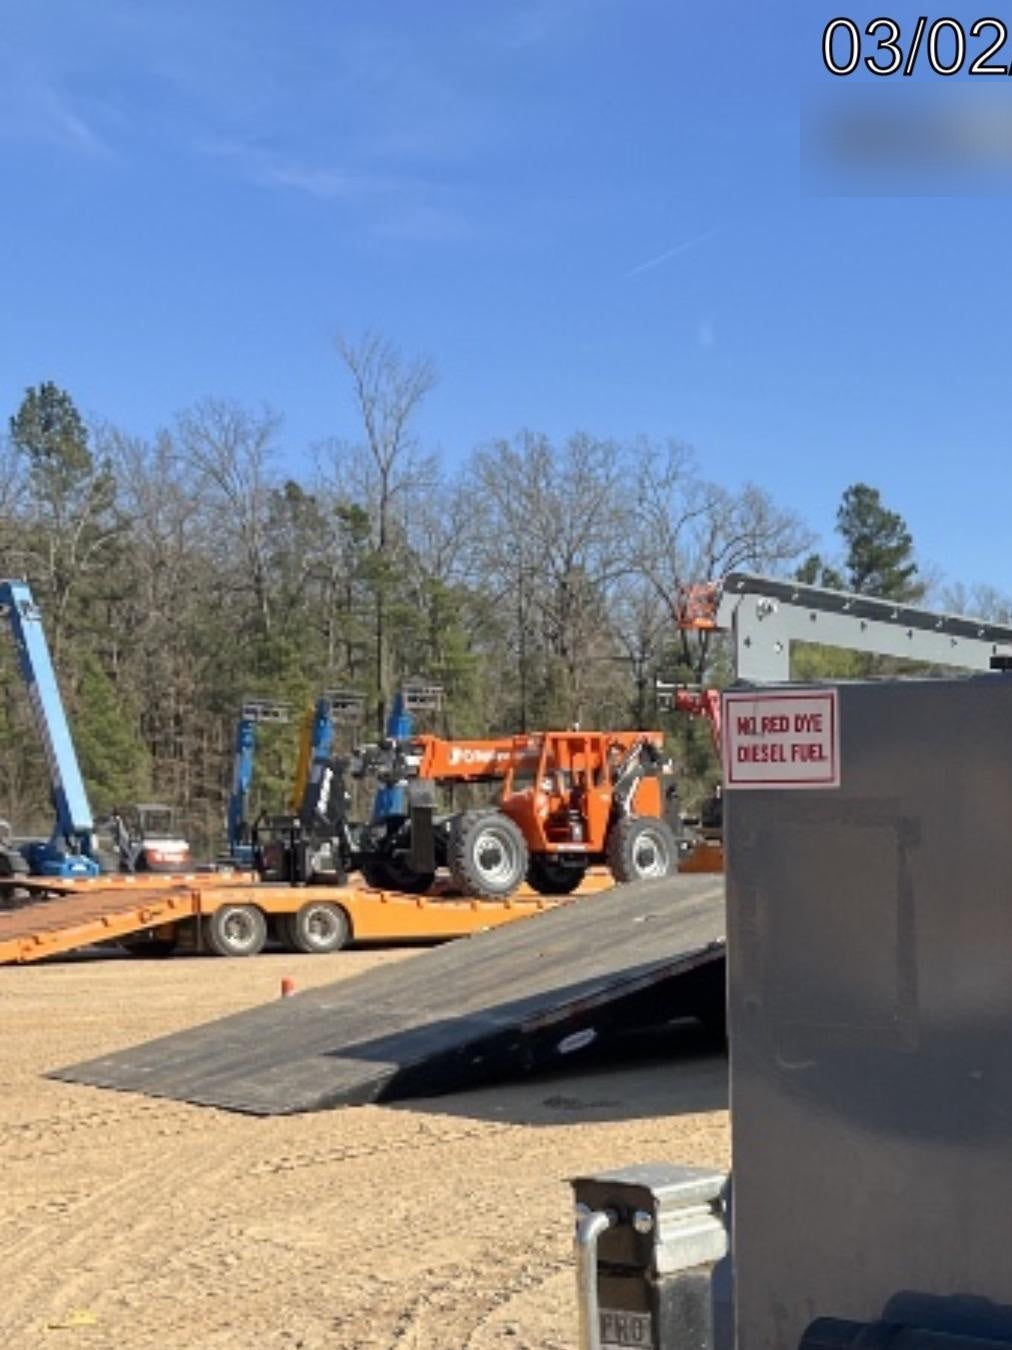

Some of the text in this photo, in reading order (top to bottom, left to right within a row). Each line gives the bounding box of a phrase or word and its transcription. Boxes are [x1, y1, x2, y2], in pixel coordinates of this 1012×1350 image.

[761, 715, 790, 734] RED
[794, 713, 823, 733] DYE
[738, 743, 828, 763] DIESEL FUEL
